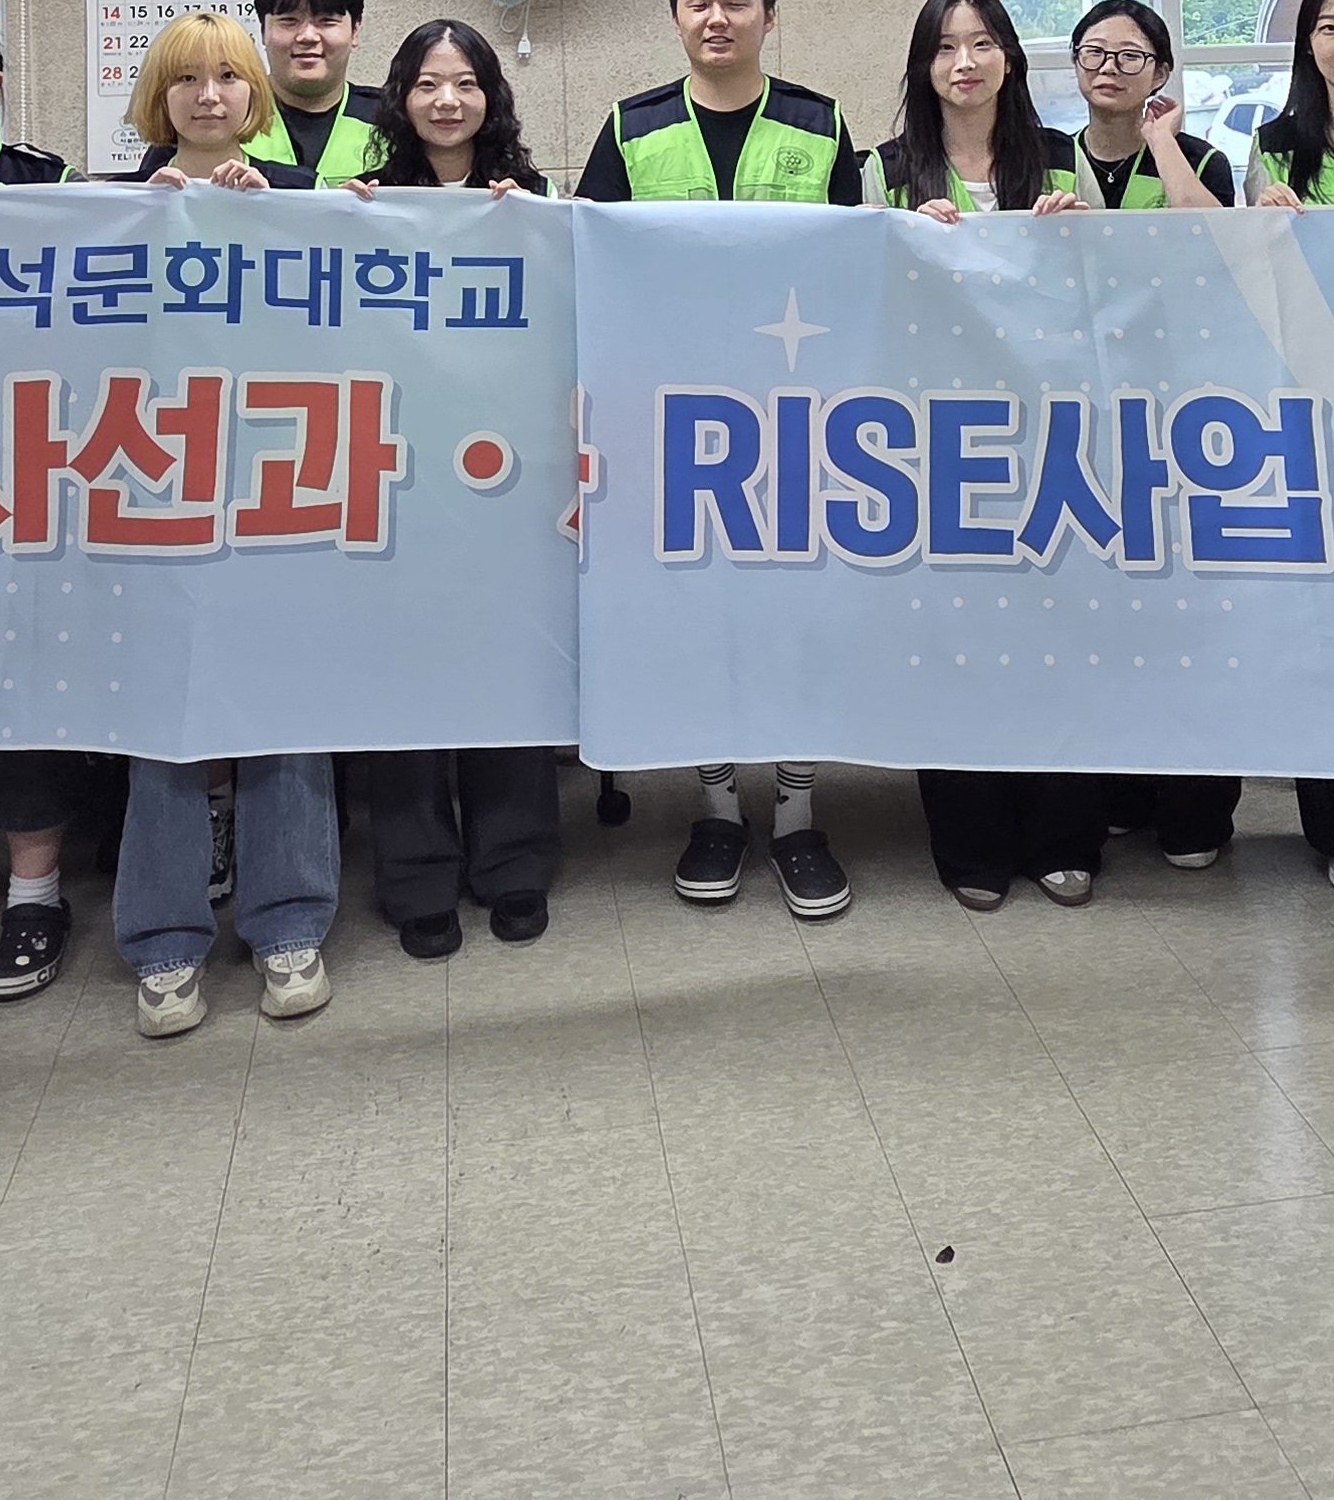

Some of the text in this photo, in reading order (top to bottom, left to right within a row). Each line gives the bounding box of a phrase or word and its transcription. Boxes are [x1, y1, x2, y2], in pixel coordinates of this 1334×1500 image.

[103, 6, 121, 19] 14
[130, 5, 148, 18] 15
[157, 5, 174, 18] 16
[237, 3, 255, 16] 19
[103, 35, 148, 50] 21 22
[102, 66, 138, 80] 28 2
[662, 392, 1327, 564] RISE사업
